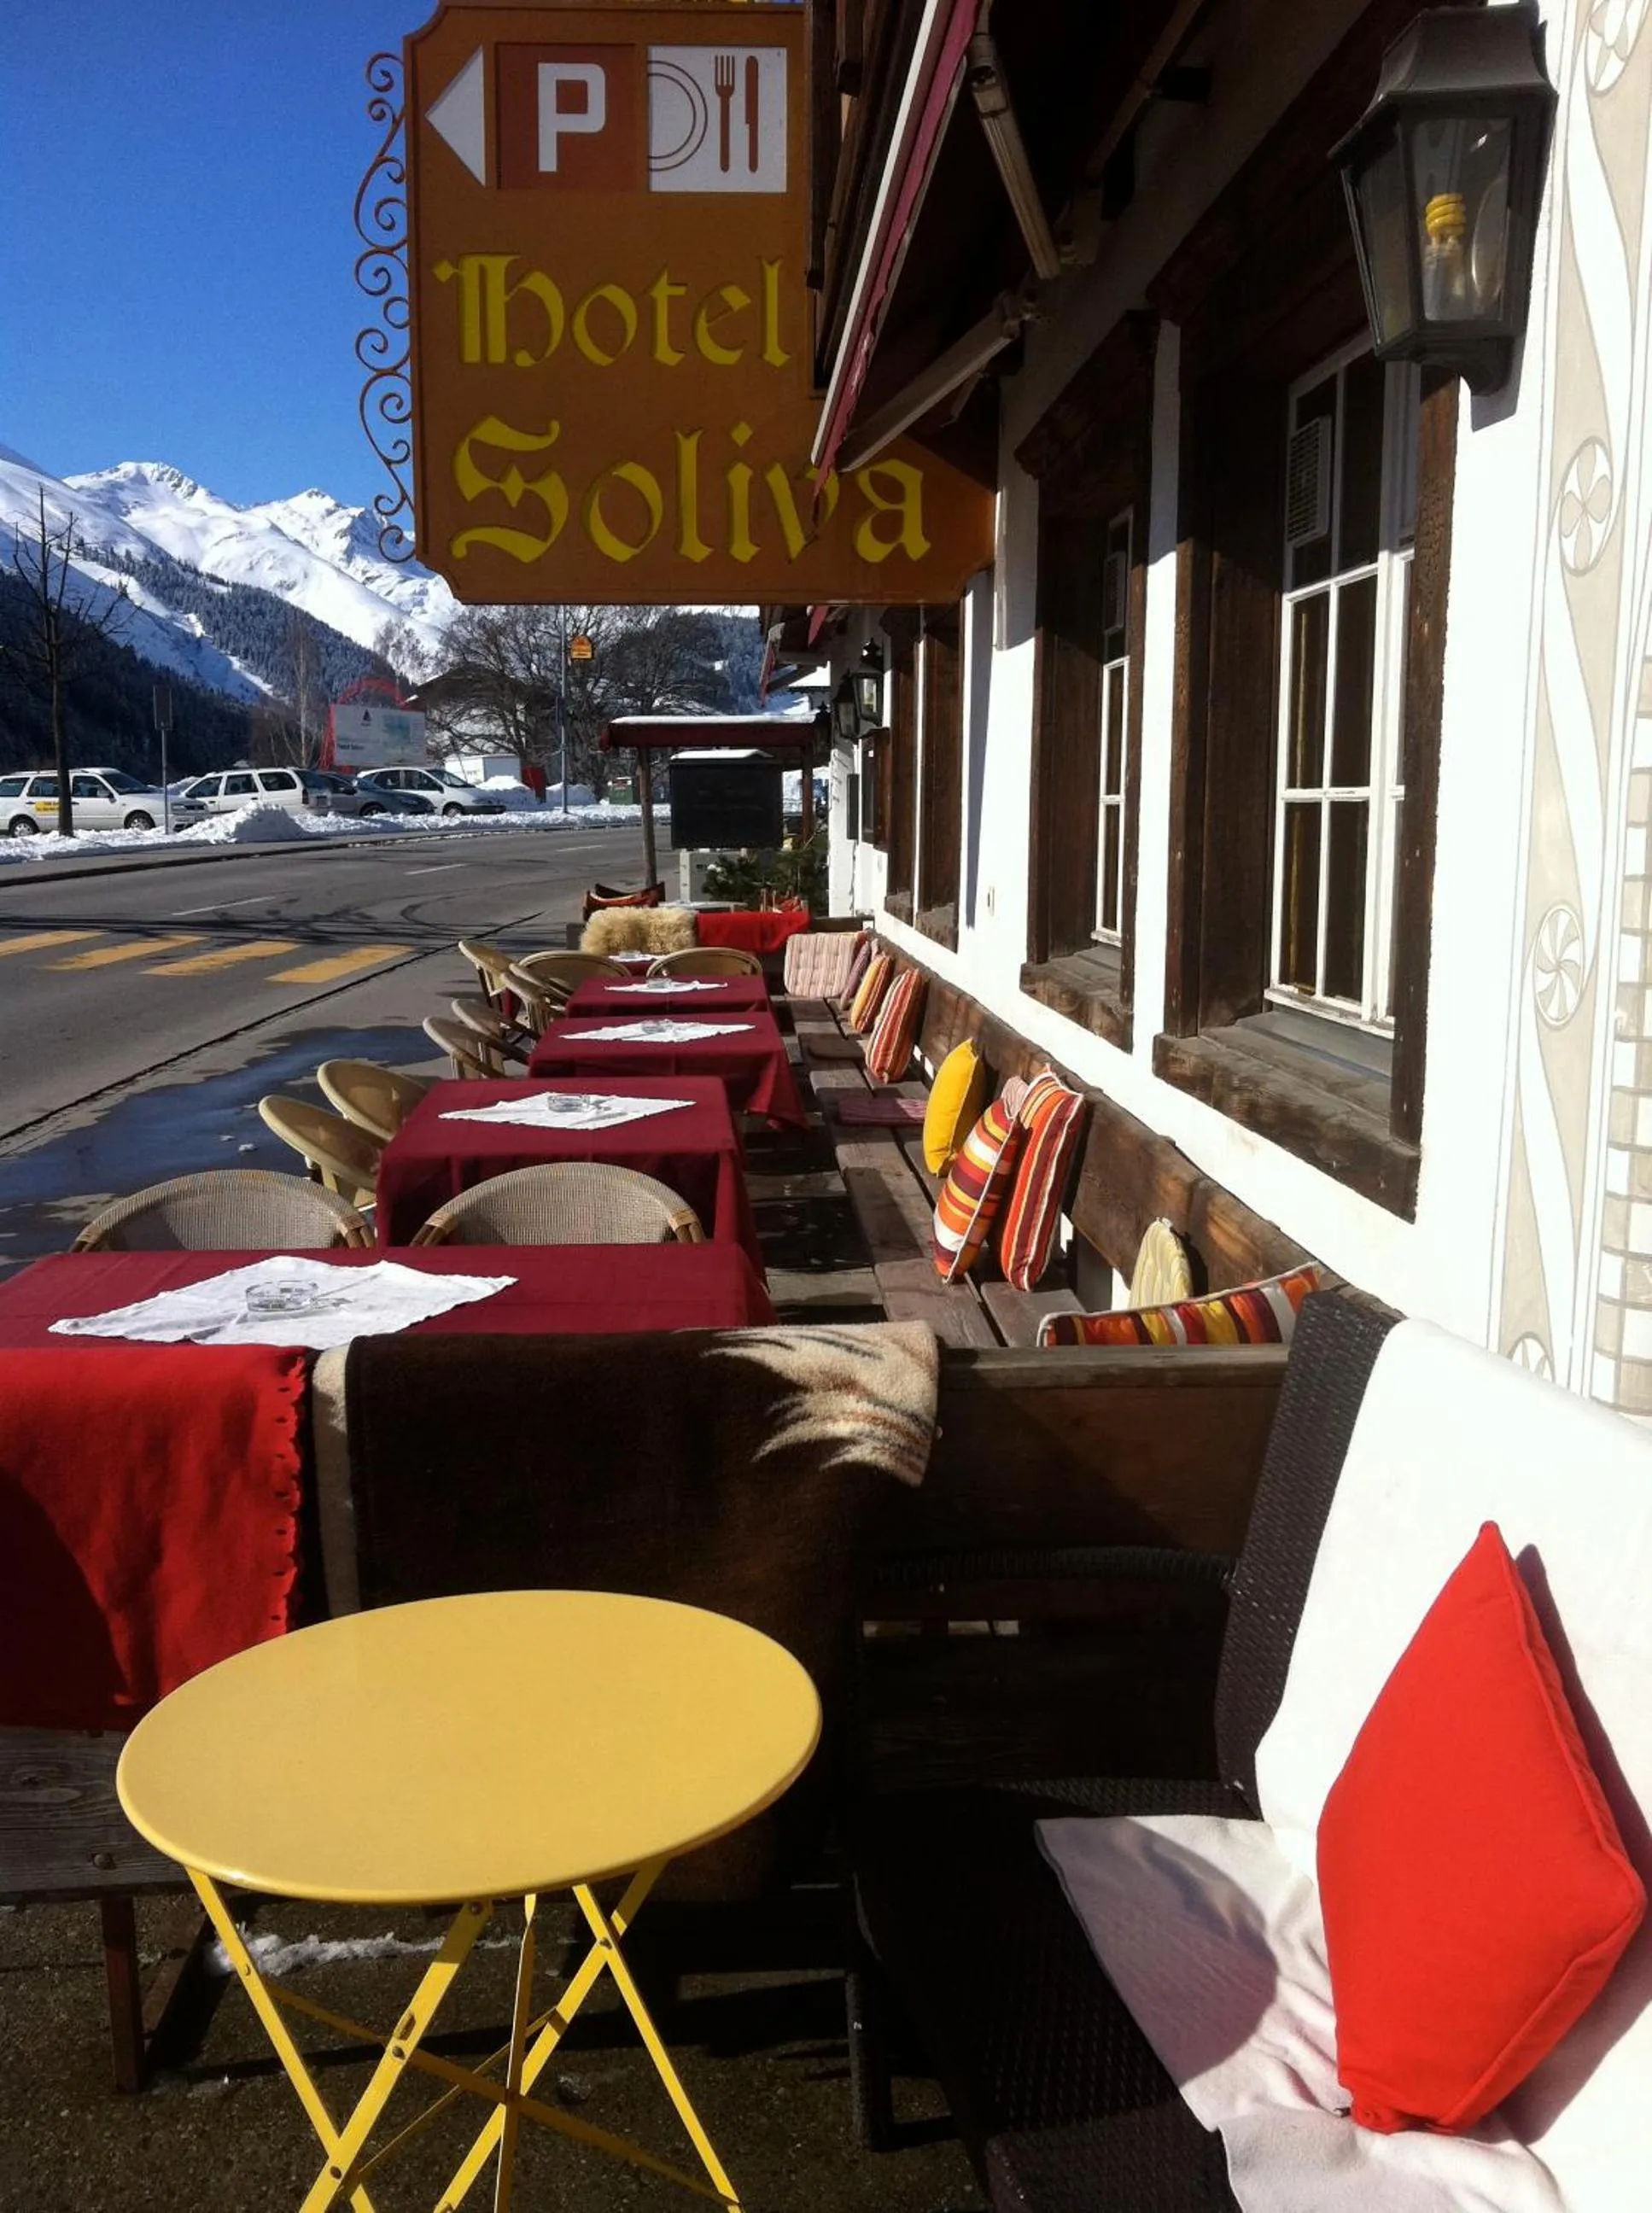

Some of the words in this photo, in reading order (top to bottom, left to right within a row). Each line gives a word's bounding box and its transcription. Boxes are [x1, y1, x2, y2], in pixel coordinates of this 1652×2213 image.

[537, 63, 605, 172] P
[433, 253, 792, 367] Hotel
[450, 415, 931, 563] Soliva
